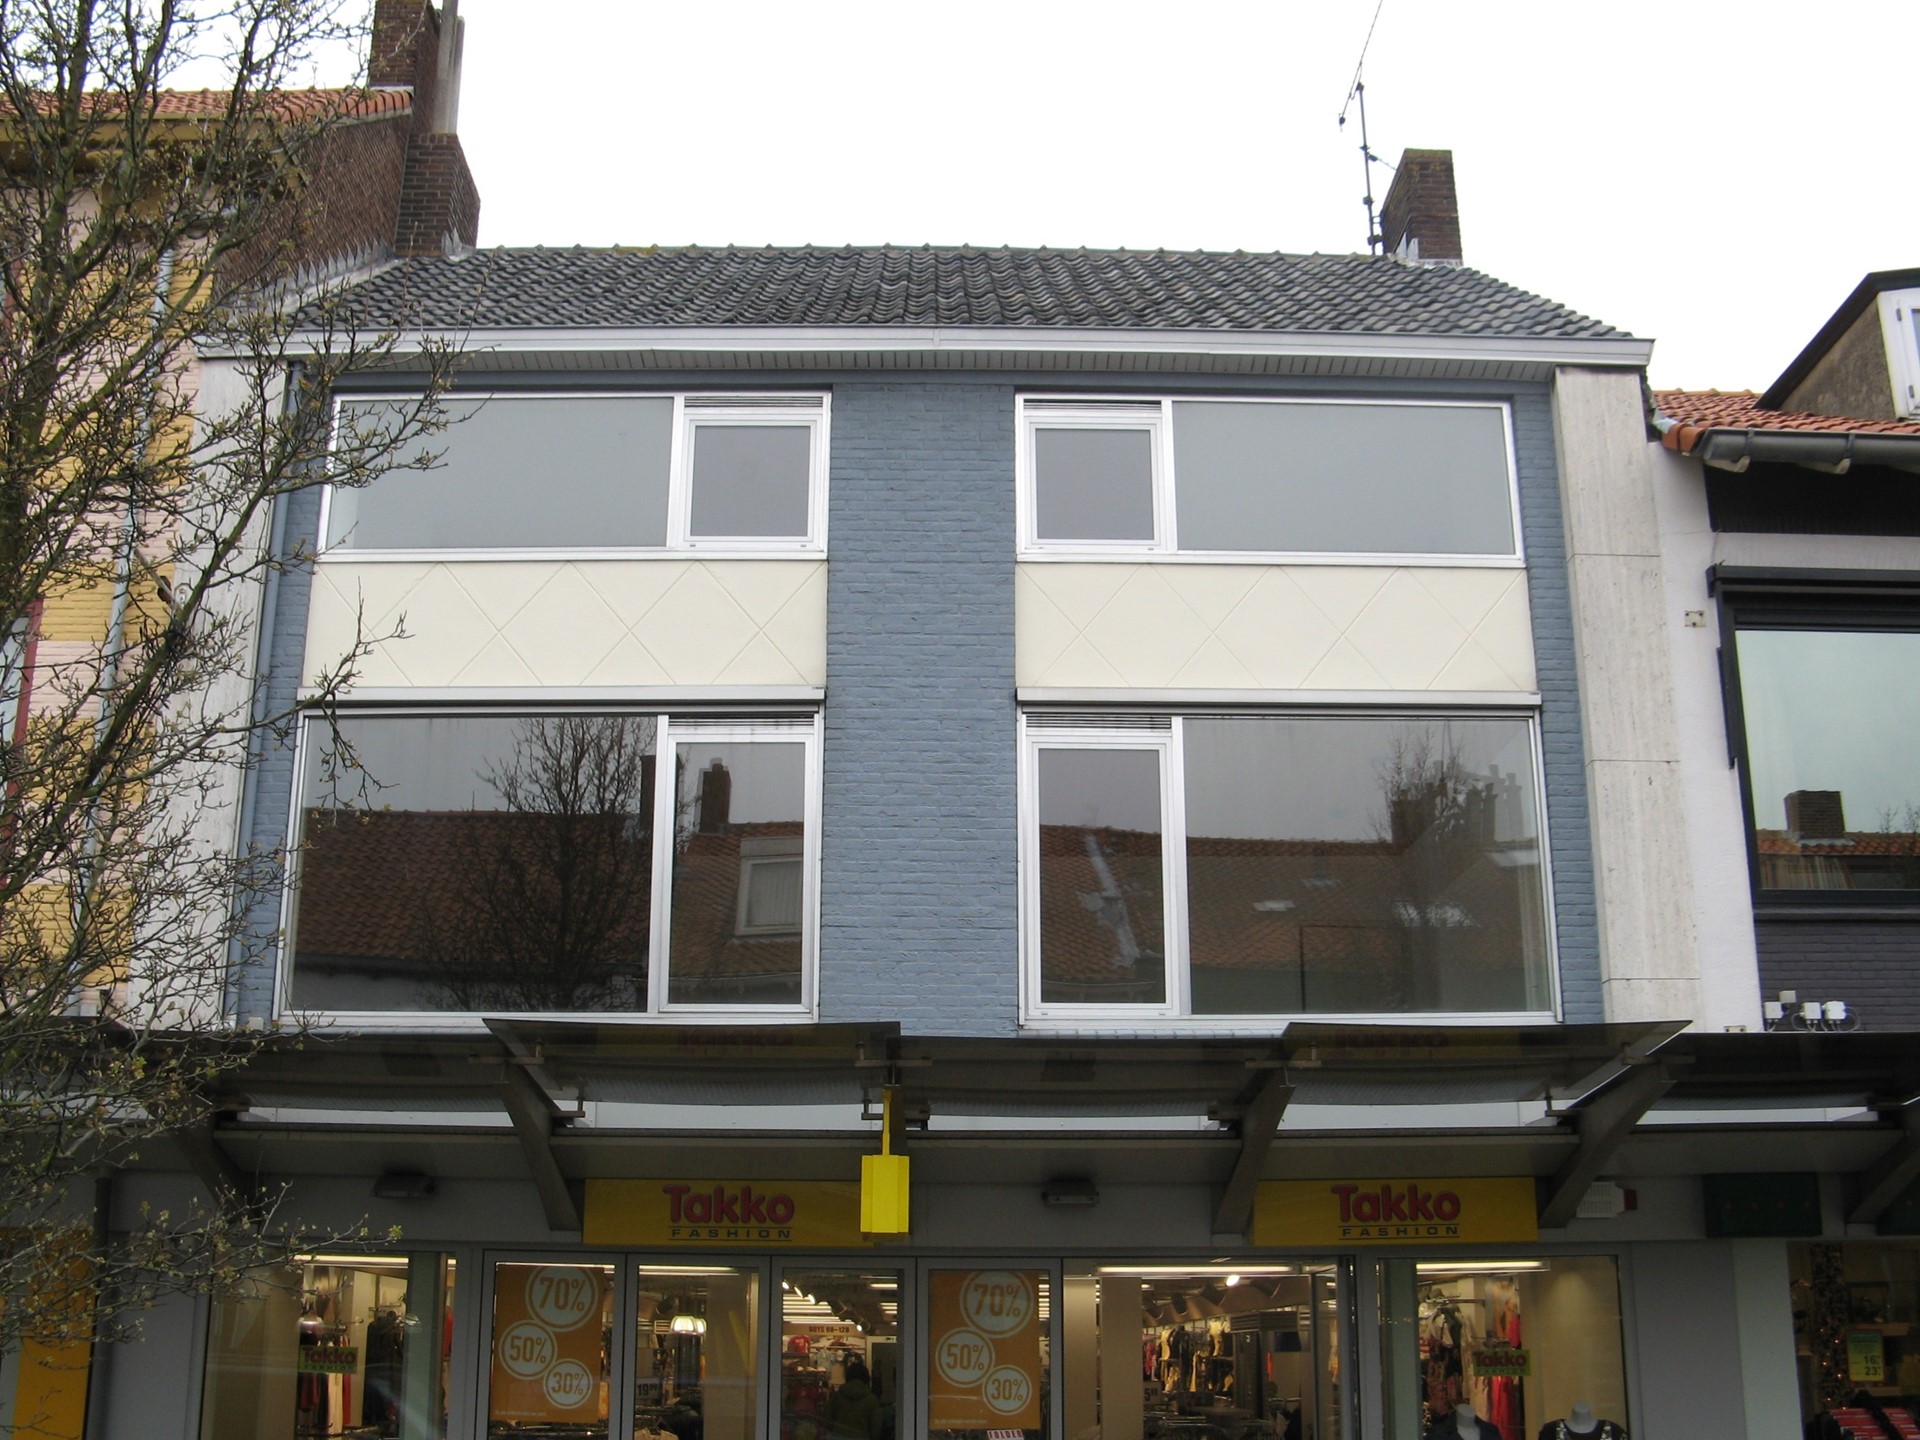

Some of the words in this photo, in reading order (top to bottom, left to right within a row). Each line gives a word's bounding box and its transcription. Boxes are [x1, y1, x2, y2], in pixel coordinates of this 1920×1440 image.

[662, 1184, 795, 1224] Takko
[1331, 1183, 1461, 1222] Takko
[671, 1229, 790, 1239] FASHION
[1342, 1226, 1458, 1236] FASHION
[538, 1276, 586, 1312] 70%
[973, 1283, 1021, 1317] 70%
[302, 1347, 356, 1363] Takko
[509, 1335, 547, 1364] 50%
[946, 1343, 985, 1371] 50%
[1472, 1350, 1527, 1367] Takko
[551, 1372, 584, 1395] 30%
[991, 1378, 1024, 1401] 30%
